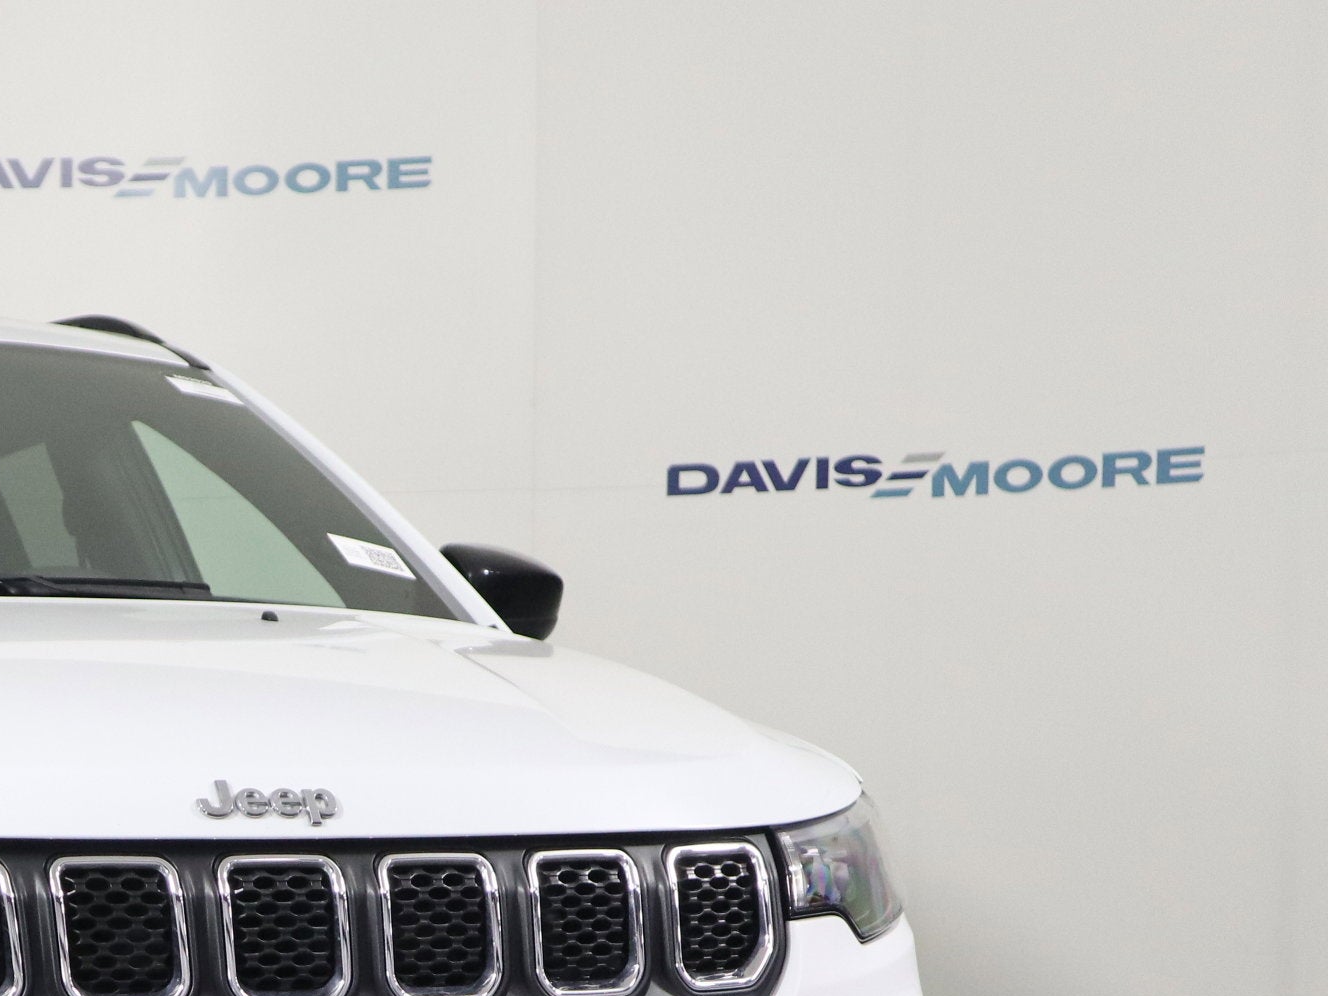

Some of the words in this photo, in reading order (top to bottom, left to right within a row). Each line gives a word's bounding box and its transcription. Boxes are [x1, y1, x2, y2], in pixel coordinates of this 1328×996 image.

[173, 155, 432, 198] MOORE
[667, 455, 883, 496] DAVIS
[931, 446, 1205, 498] MOORE
[196, 779, 339, 827] Jeep
